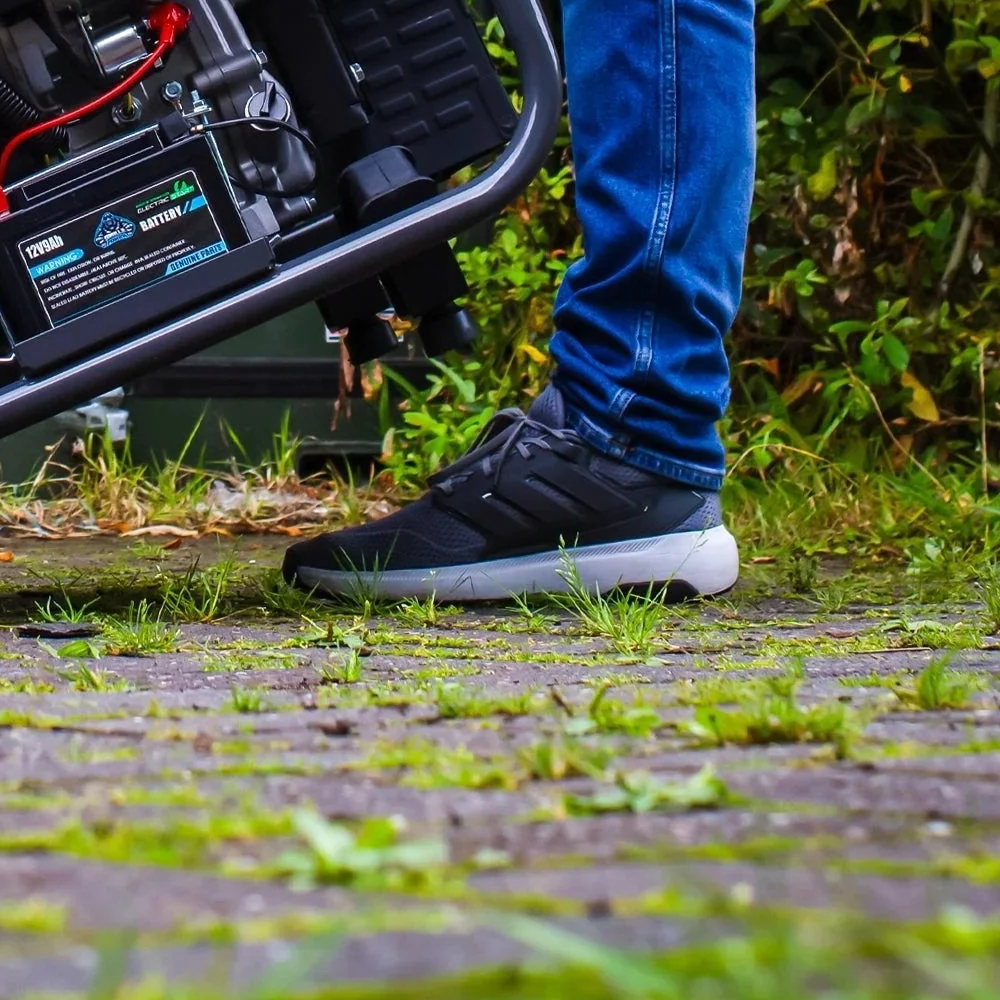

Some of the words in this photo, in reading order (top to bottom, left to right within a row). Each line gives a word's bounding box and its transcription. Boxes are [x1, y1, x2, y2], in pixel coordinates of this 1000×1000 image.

[139, 204, 182, 232] BATTERY
[25, 234, 65, 260] 12V9Ah
[201, 244, 223, 260] PARTS
